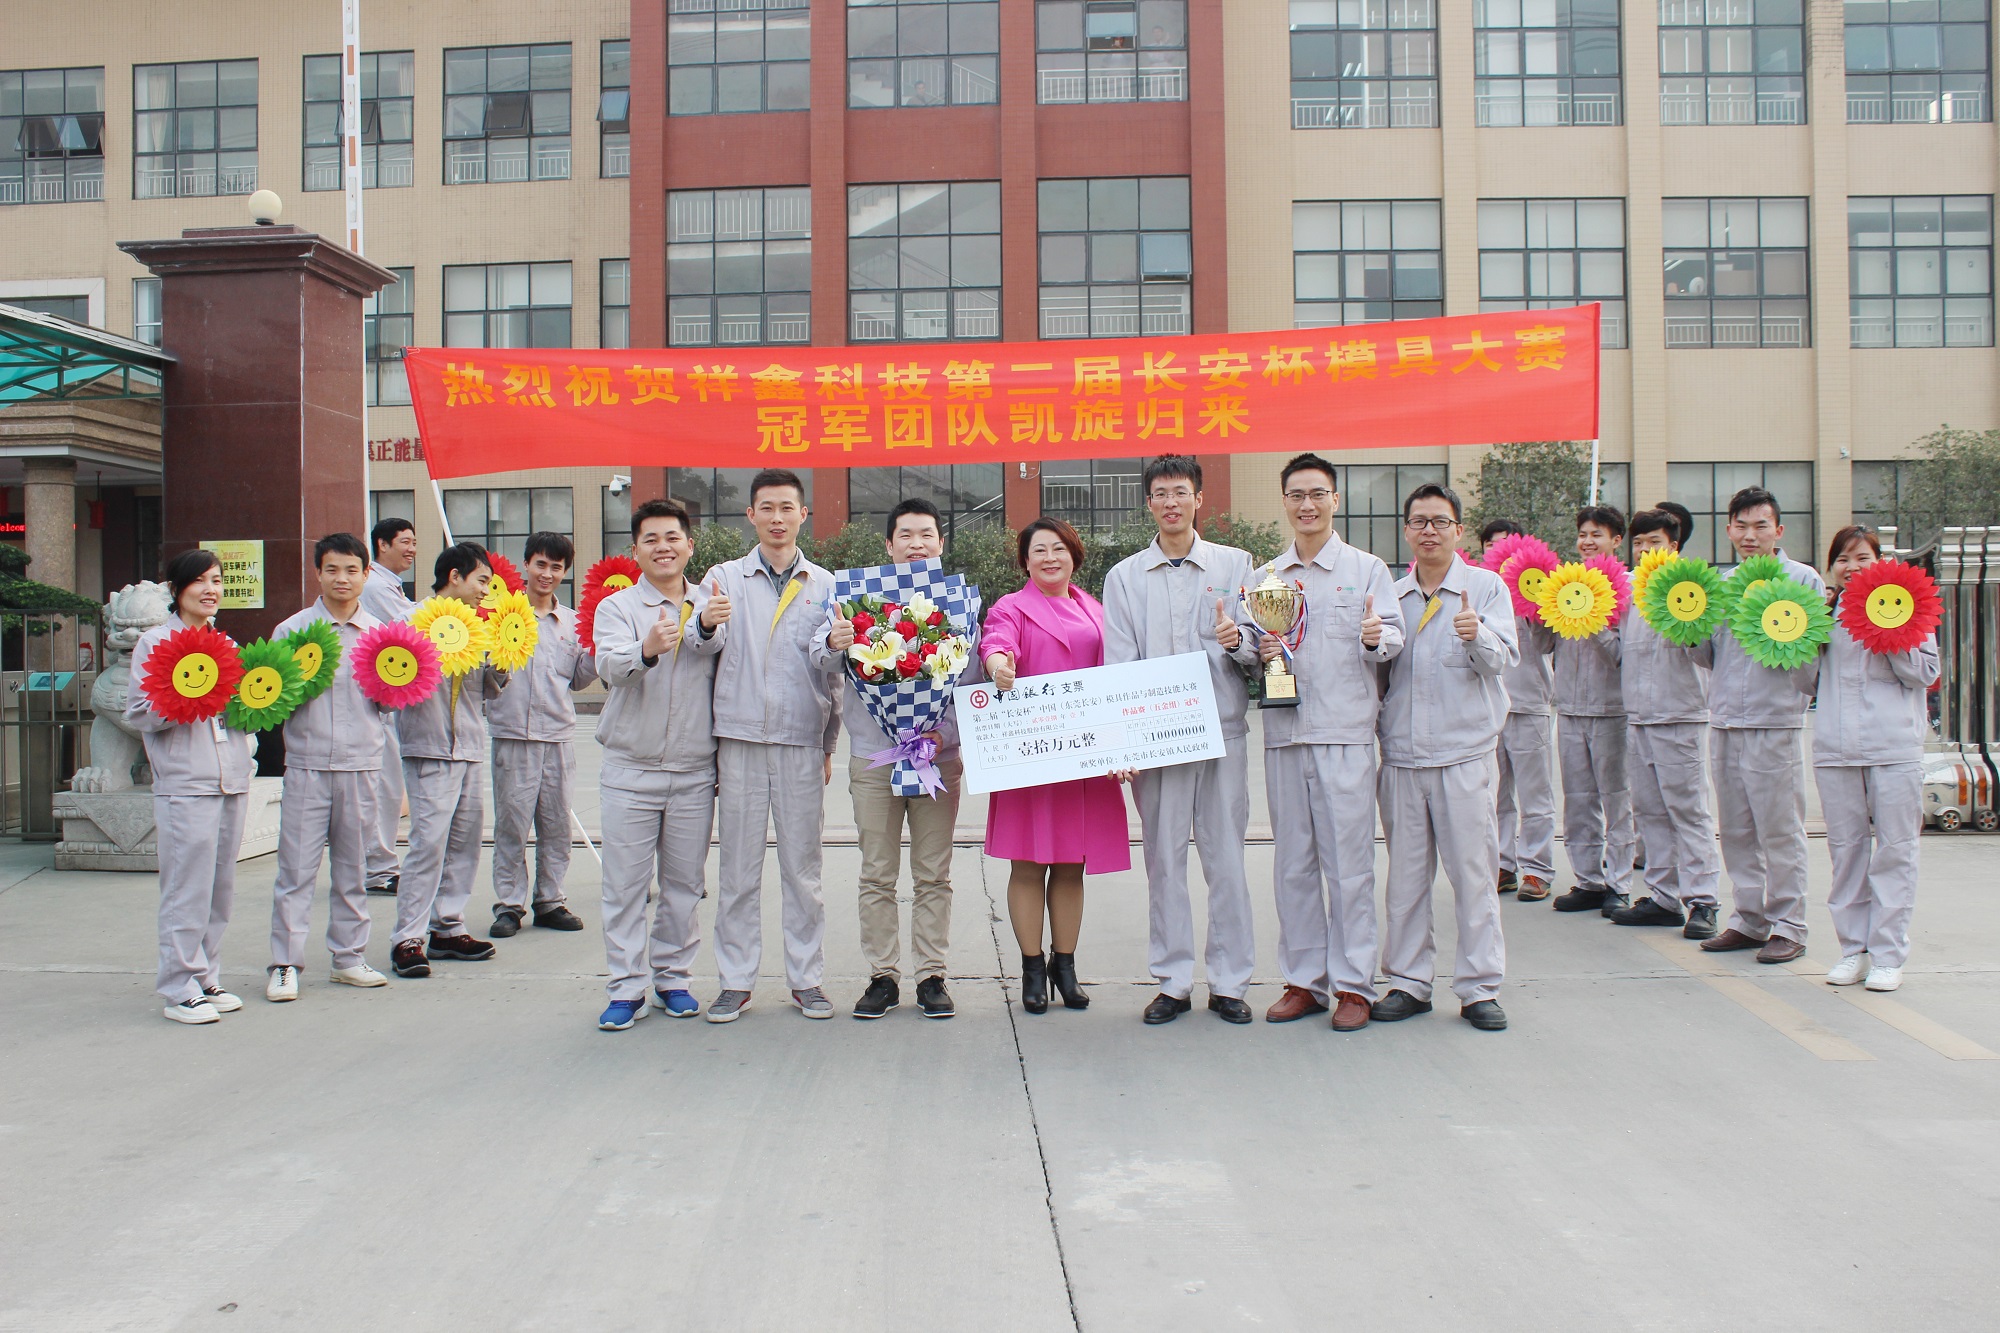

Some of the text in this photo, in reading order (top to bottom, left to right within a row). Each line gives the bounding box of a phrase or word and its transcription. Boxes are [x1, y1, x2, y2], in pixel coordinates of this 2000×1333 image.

[441, 324, 1567, 408] 热烈祝贺祥鑫科技第二届长安杯模具大赛
[756, 393, 1250, 454] 冠军团队凯旋归来
[1018, 732, 1097, 757] 壹拾万元整
